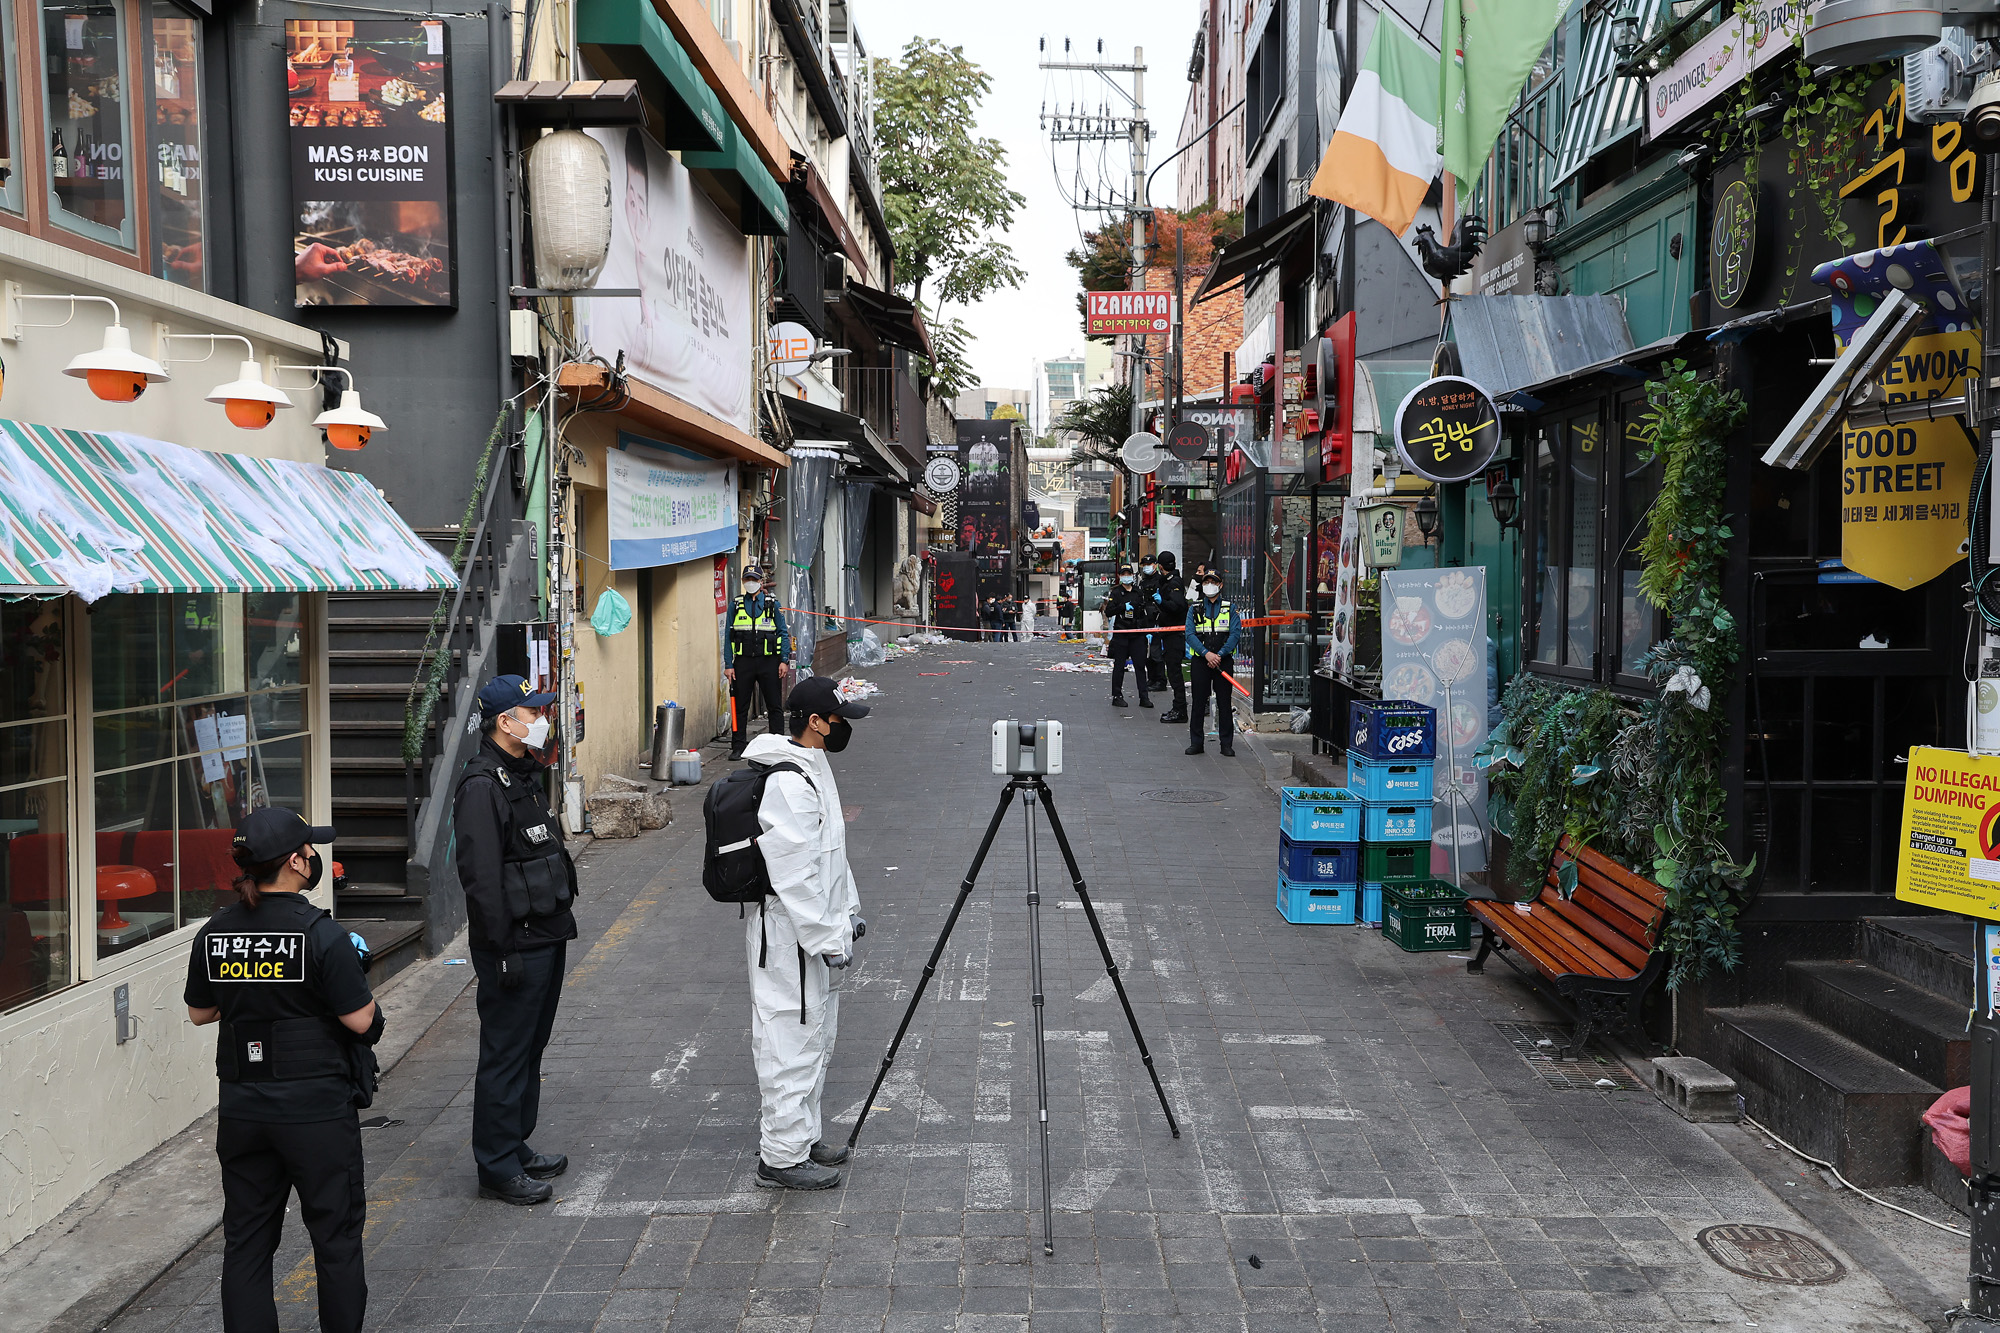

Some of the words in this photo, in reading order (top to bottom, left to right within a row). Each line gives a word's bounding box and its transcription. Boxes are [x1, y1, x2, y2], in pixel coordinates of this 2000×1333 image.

[1668, 62, 1707, 105] ERDINGER
[308, 145, 354, 163] MAS
[383, 145, 429, 163] BON
[314, 168, 353, 182] KUSI
[356, 168, 424, 182] CUISINE
[664, 247, 699, 328] 이태원
[699, 273, 729, 339] 클라쓰
[1090, 295, 1168, 315] IZAKAYA
[1156, 320, 1166, 329] 2F
[1440, 391, 1475, 404] 달달하게
[1460, 402, 1476, 410] NIGHT
[1175, 436, 1203, 447] XOLO
[1407, 416, 1496, 462] 꿀밤
[1843, 428, 1918, 461] FOOD
[1041, 477, 1069, 491] JAZZ
[1843, 461, 1946, 496] STREET
[1842, 505, 1878, 523] 이태원
[1380, 547, 1392, 557] Pils
[1387, 729, 1424, 753] Cass
[1916, 766, 1938, 782] NO
[1940, 769, 2000, 792] ILLEGAL
[1914, 785, 1986, 810] DUMPING
[1911, 832, 1935, 842] charged
[1950, 848, 1964, 857] fine.
[1957, 890, 1975, 900] including
[1424, 924, 1457, 938] TERRA
[211, 937, 297, 959] 과학수사
[219, 962, 285, 979] POLICE
